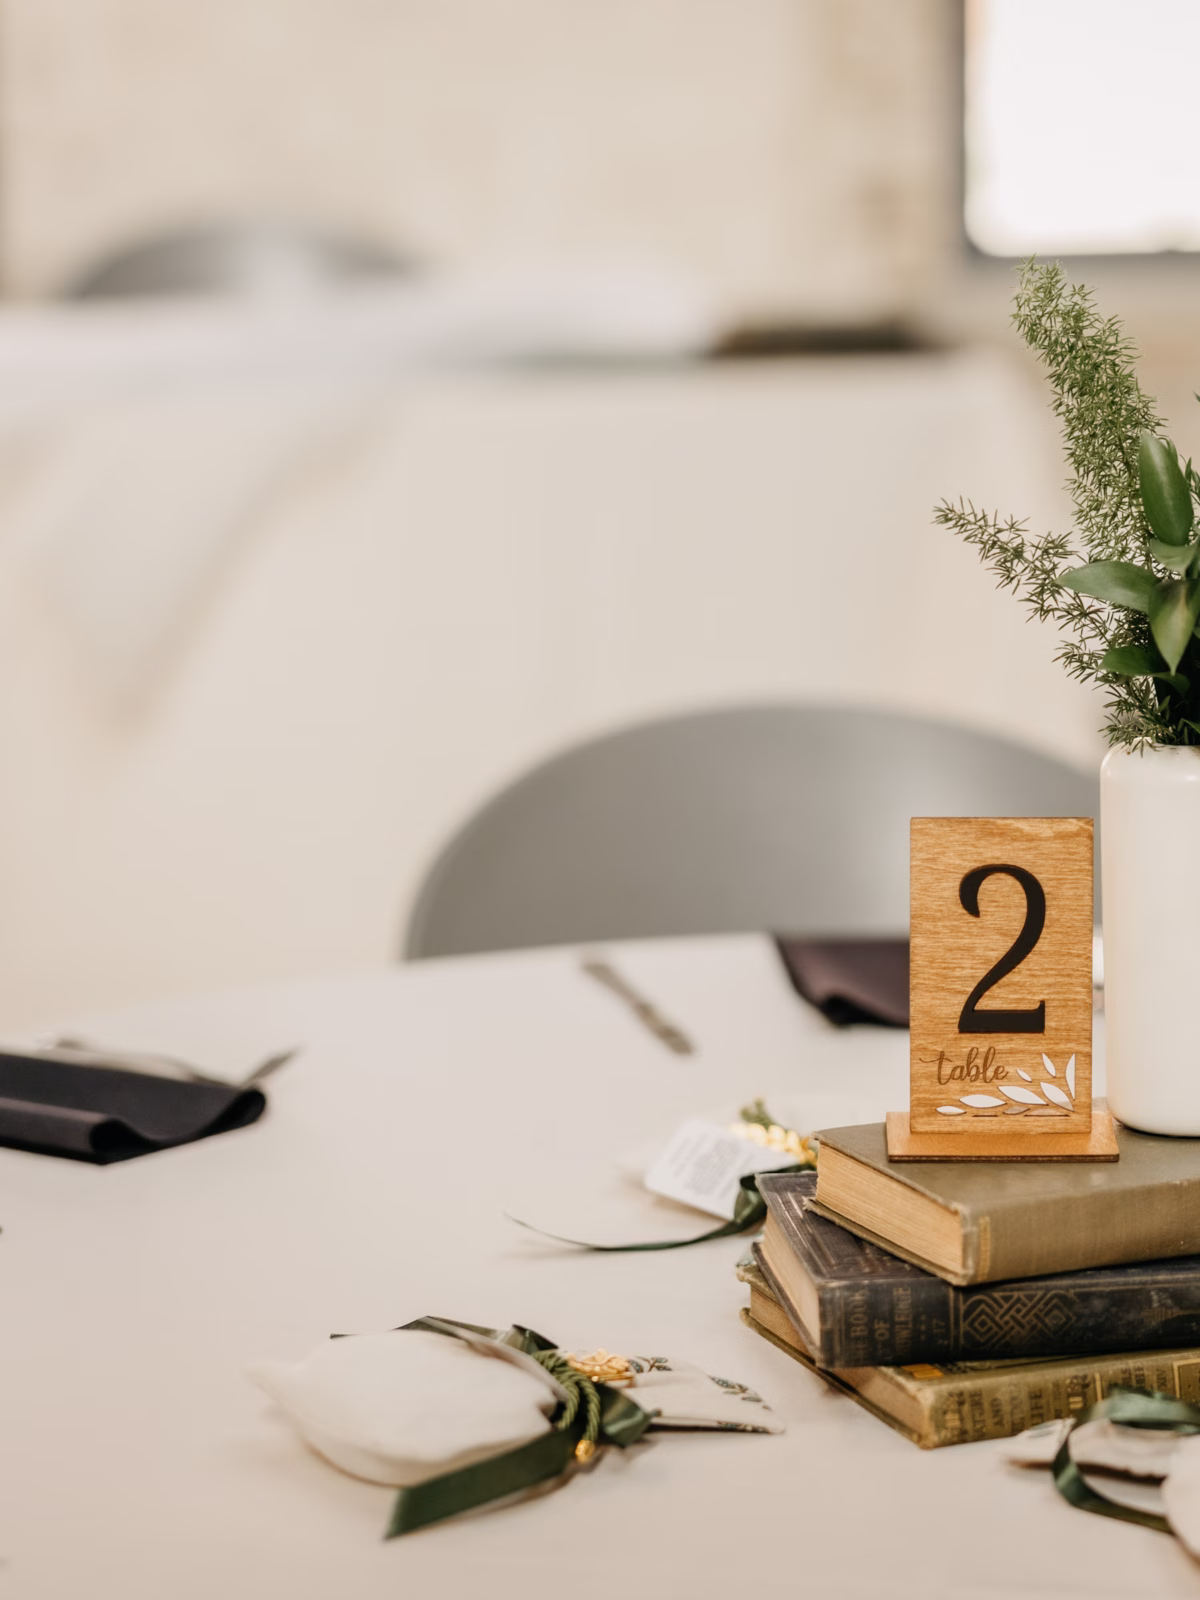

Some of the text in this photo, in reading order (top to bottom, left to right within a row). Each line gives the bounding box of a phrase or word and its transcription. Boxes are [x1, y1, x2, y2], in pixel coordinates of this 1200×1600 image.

[957, 863, 1046, 1034] 2
[919, 1047, 1010, 1086] table
[850, 1289, 869, 1337] BOOK
[874, 1318, 890, 1341] OF
